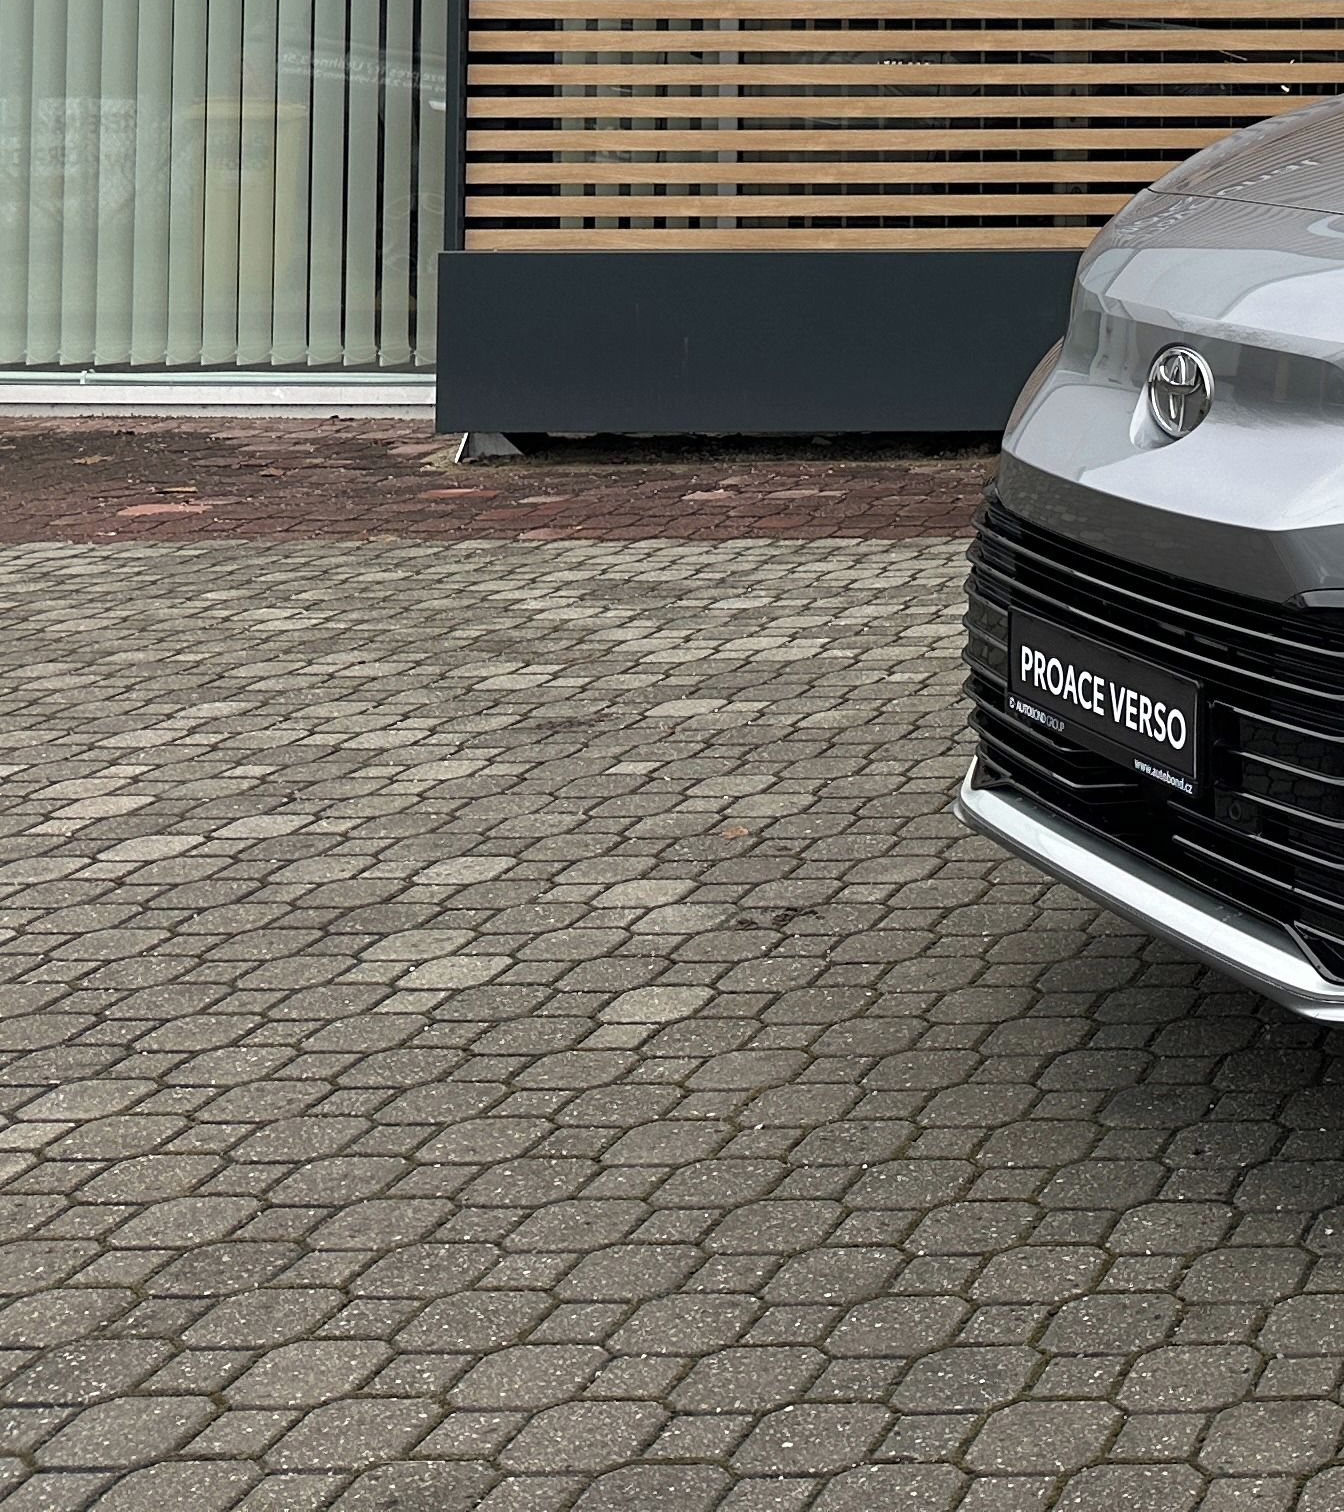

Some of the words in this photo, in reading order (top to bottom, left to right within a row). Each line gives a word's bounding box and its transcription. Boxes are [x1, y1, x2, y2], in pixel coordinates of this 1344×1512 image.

[1021, 645, 1105, 717] PROACE
[1109, 682, 1187, 750] VERSO
[1134, 758, 1193, 795] www.autobond.cz
